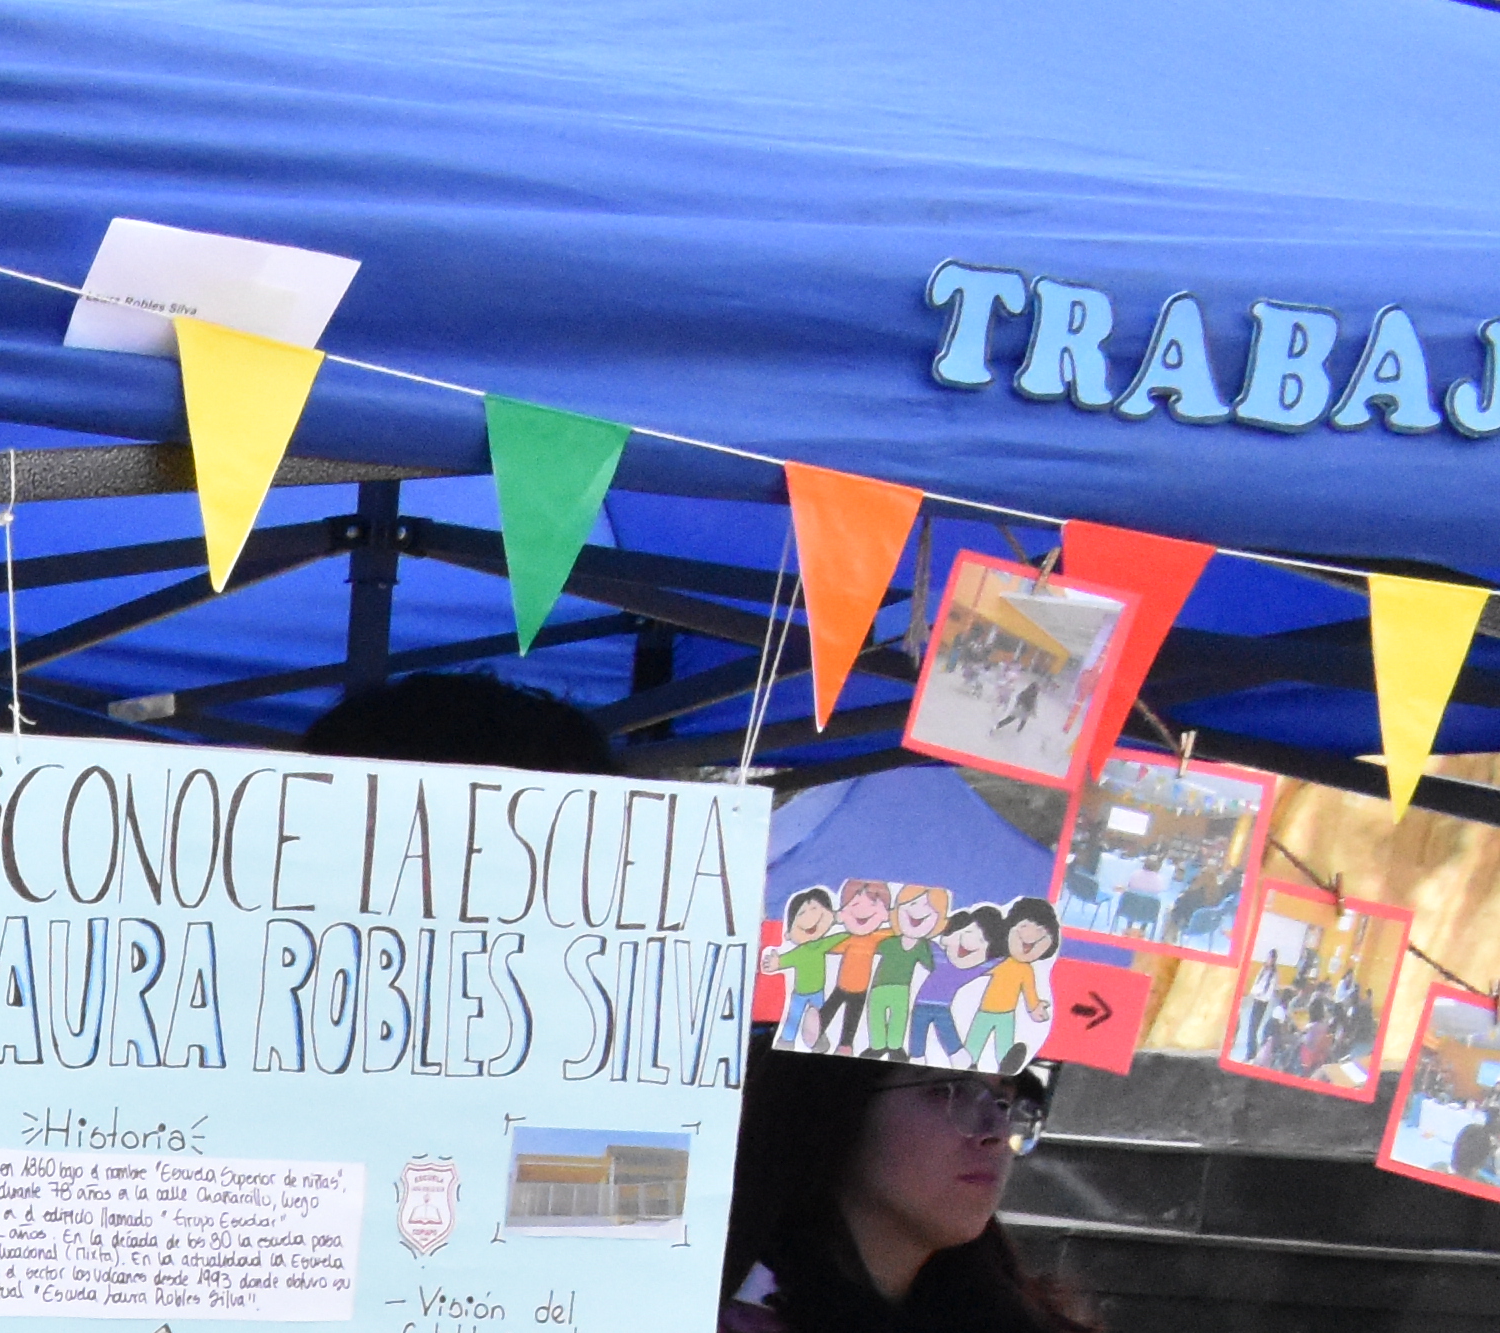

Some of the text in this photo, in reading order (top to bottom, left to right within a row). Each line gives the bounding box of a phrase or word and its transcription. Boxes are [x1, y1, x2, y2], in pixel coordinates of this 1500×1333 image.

[125, 296, 165, 311] Robles
[169, 303, 197, 315] Silva
[2, 763, 736, 939] CONOCE LA ESCUELA
[252, 920, 532, 1078] ROBLES
[562, 933, 748, 1091] SILVA
[44, 1106, 187, 1151] Historia
[59, 1162, 83, 1185] bajo
[106, 1164, 147, 1180] nombre
[221, 1167, 276, 1190] Superior
[284, 1169, 297, 1186] de
[48, 1182, 72, 1201] 78
[77, 1184, 111, 1200] años
[135, 1186, 148, 1201] la
[156, 1186, 187, 1201] calle
[101, 1207, 153, 1228] llamado
[63, 1229, 82, 1244] En
[90, 1229, 103, 1246] la
[166, 1234, 180, 1250] de
[238, 1234, 252, 1248] la
[312, 1234, 343, 1252] pasa
[132, 1253, 151, 1265] En
[158, 1253, 174, 1266] la
[182, 1252, 261, 1267] actualidad
[270, 1253, 286, 1267] la
[291, 1253, 344, 1270] Escuela
[26, 1265, 65, 1280] sector
[154, 1271, 189, 1287] desde
[197, 1268, 232, 1289] 1993
[239, 1272, 279, 1290] donde
[155, 1288, 201, 1307] Robles
[419, 1286, 575, 1325] Visión del
